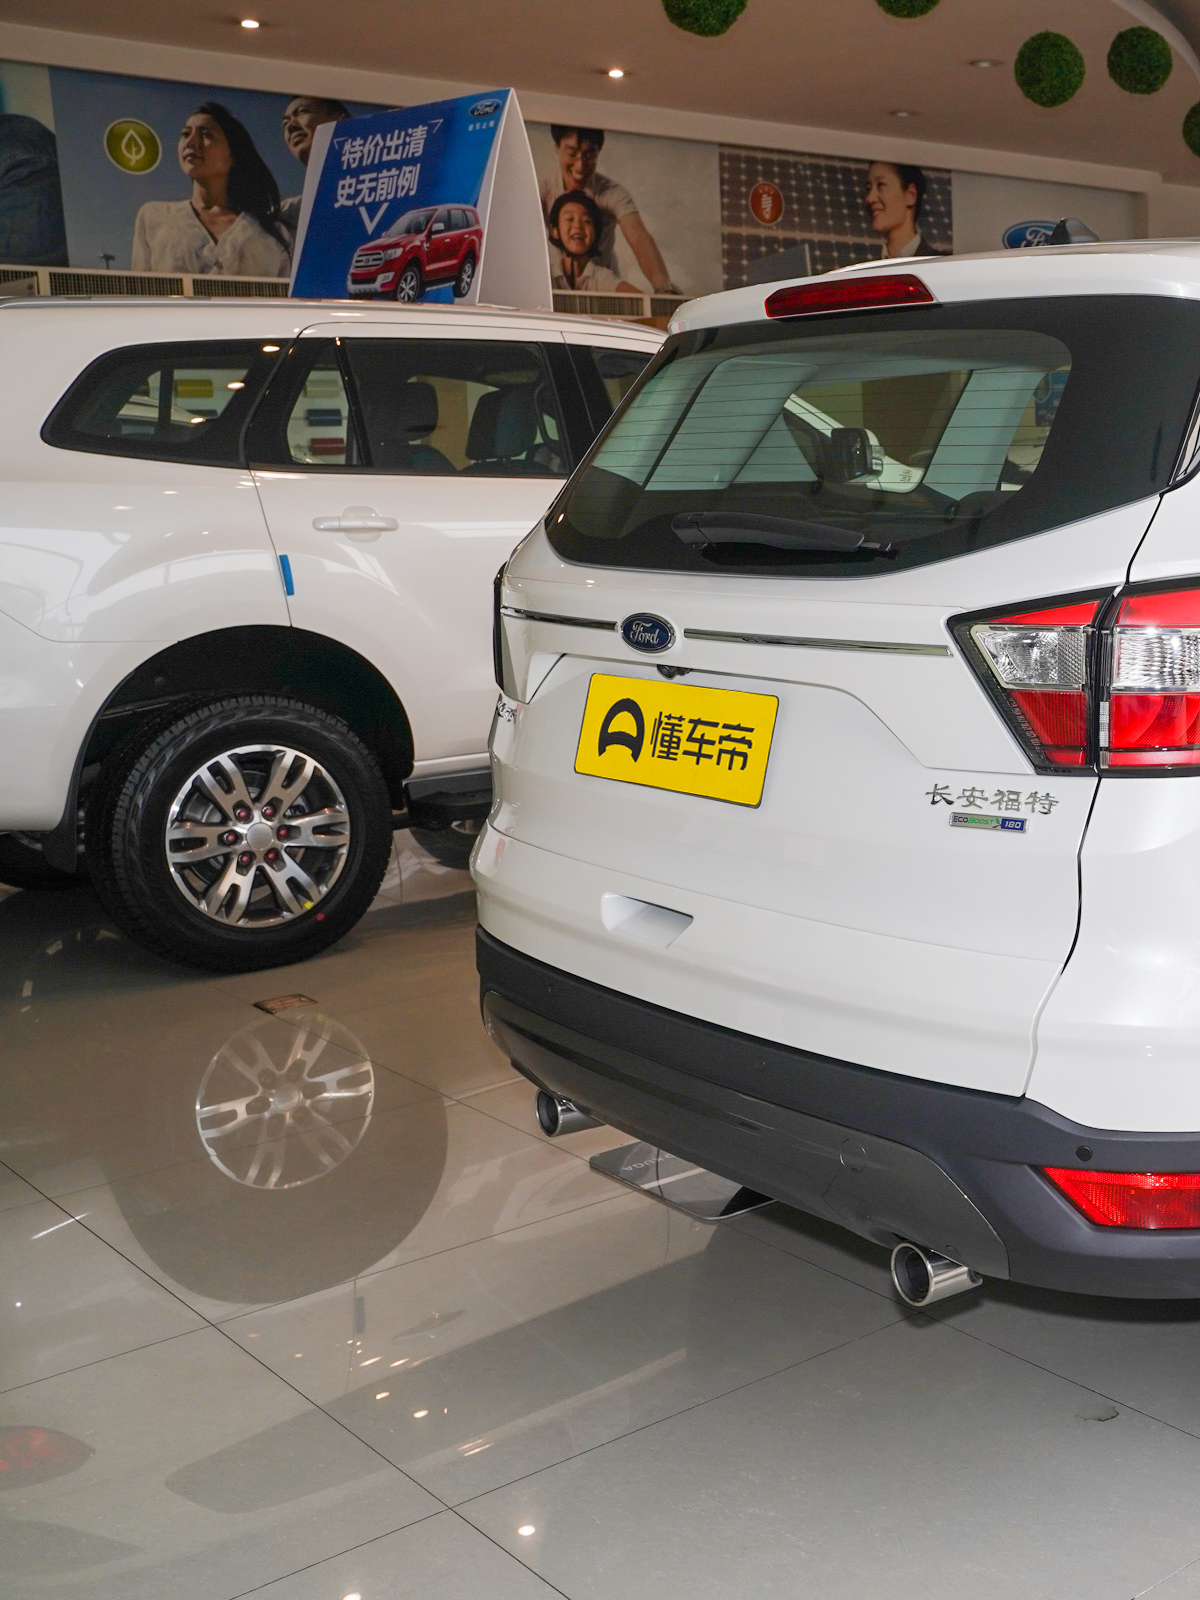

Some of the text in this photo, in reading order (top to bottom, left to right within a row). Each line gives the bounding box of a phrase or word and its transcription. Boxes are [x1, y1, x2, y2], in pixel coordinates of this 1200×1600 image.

[341, 125, 428, 170] 特价出清
[334, 163, 421, 208] 史无前例
[629, 620, 660, 645] Ford
[650, 710, 755, 772] 懂车帝
[925, 783, 1059, 815] 长安福特
[1004, 820, 1022, 829] 180
